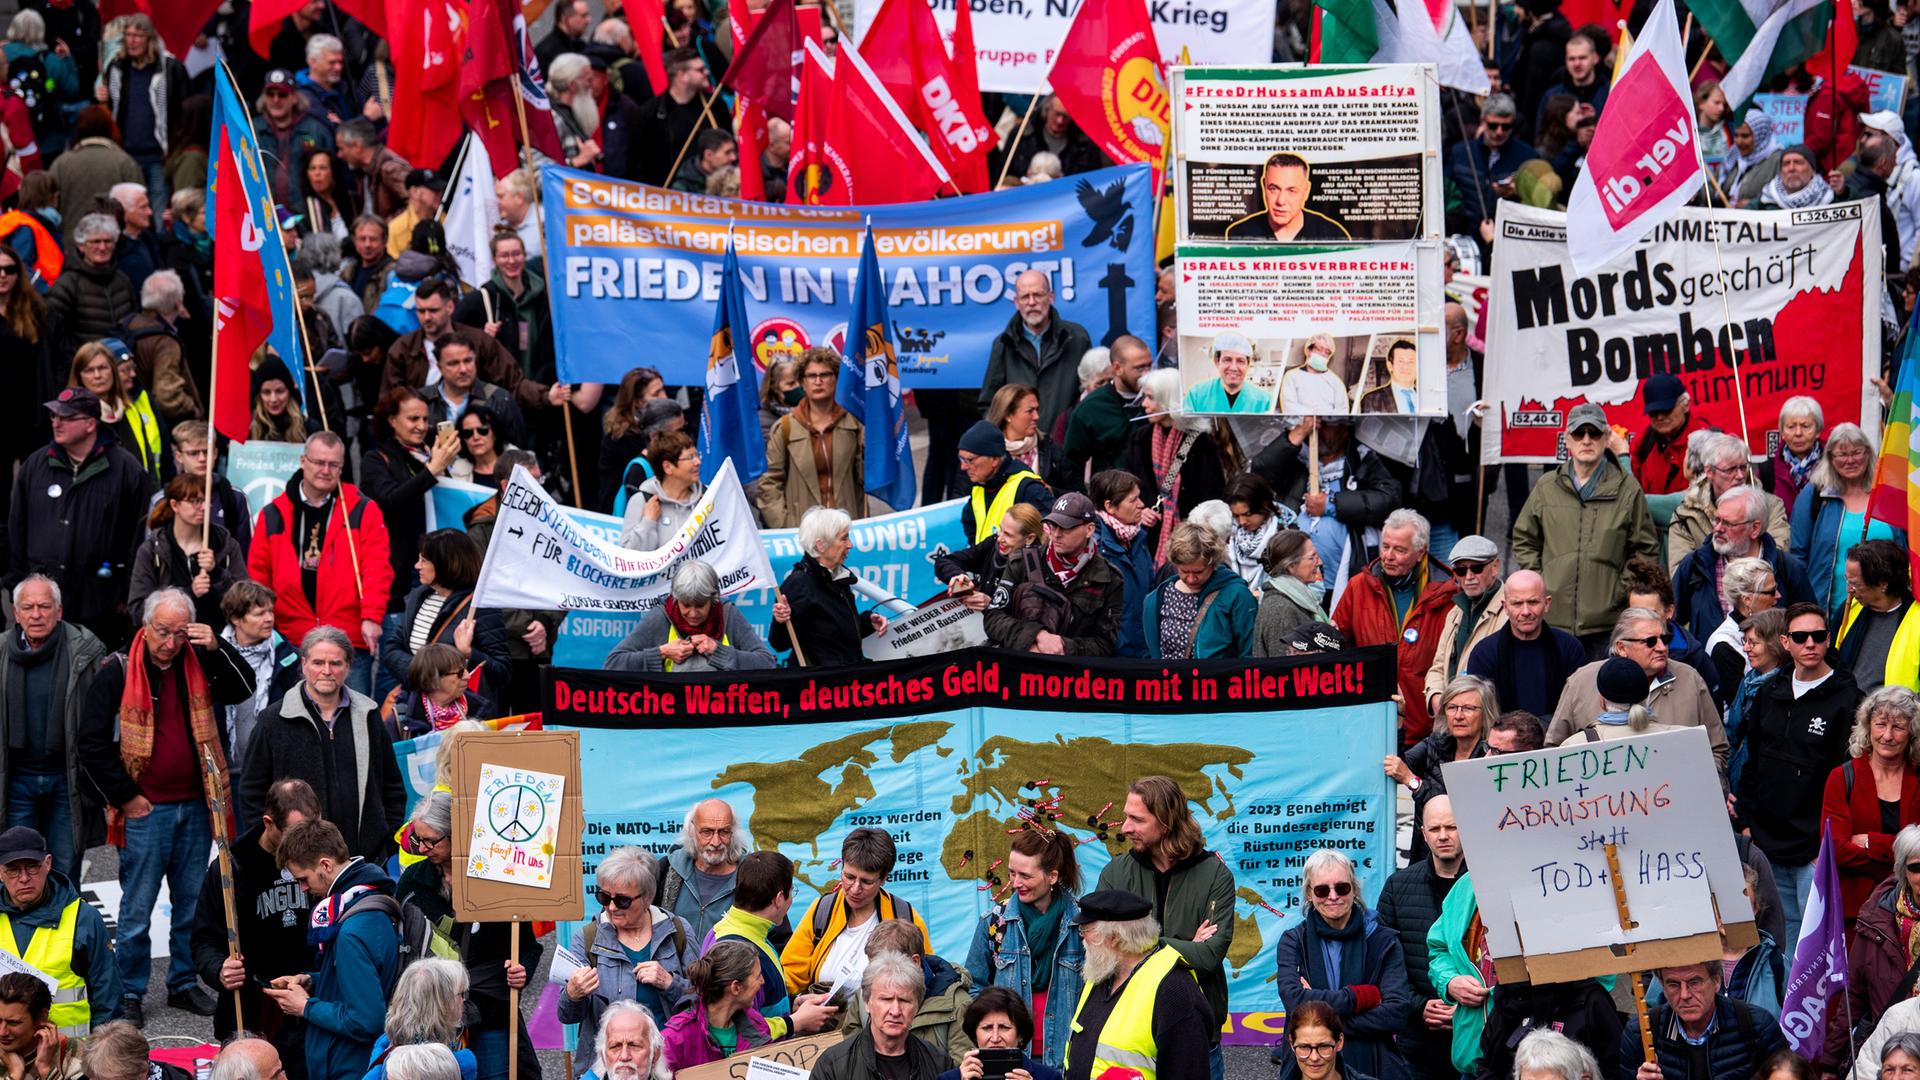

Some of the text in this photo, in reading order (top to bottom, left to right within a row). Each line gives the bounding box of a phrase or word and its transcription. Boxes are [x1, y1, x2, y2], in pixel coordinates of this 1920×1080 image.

[1150, 1, 1228, 33] Krieg
[976, 48, 1038, 67] ruppe
[1185, 85, 1415, 97] #FreeDrHussamAbuSafiya
[920, 74, 979, 155] DKP
[1796, 208, 1859, 222] 1.326,50 €
[572, 219, 850, 254] palästinensischen
[1507, 225, 1556, 239] Die Aktie
[1640, 219, 1789, 244] INMETALL
[1183, 262, 1414, 271] ISRAELS KRIEGSVERBRECHEN:
[565, 255, 1076, 307] FRIEDEN IN AHOST!
[1567, 312, 1777, 388] Bomben
[1685, 361, 1826, 408] timmung
[1514, 412, 1558, 425] 52,40 €
[532, 532, 563, 565] FÜR
[891, 608, 976, 650] Frieden mit Russland
[893, 622, 910, 634] NIE
[908, 608, 942, 627] WIEDER
[555, 660, 1364, 719] Deutsche Waffen, deutsches Geld, morden mit in aller Welt!
[1487, 745, 1650, 793] FRIEDEN
[483, 772, 555, 805] FRIEDEN
[1249, 799, 1367, 817] 2023 genehmigt
[1497, 783, 1671, 832] ABRÜSTUNG
[850, 810, 942, 826] 2022 werden
[588, 822, 611, 835] Die
[1227, 819, 1376, 836] die Bundesregierung
[892, 830, 911, 843] eit
[582, 843, 605, 855] ind
[1243, 837, 1366, 854] Rüstungsexporte
[513, 846, 525, 866] in
[528, 855, 544, 869] uns
[896, 850, 924, 864] ege
[1239, 858, 1372, 870] für 12 €
[503, 867, 516, 877] an
[582, 862, 597, 875] ür
[1639, 849, 1703, 885] HASS
[886, 869, 930, 883] eführt
[1272, 876, 1304, 888] meh
[1285, 894, 1300, 909] je
